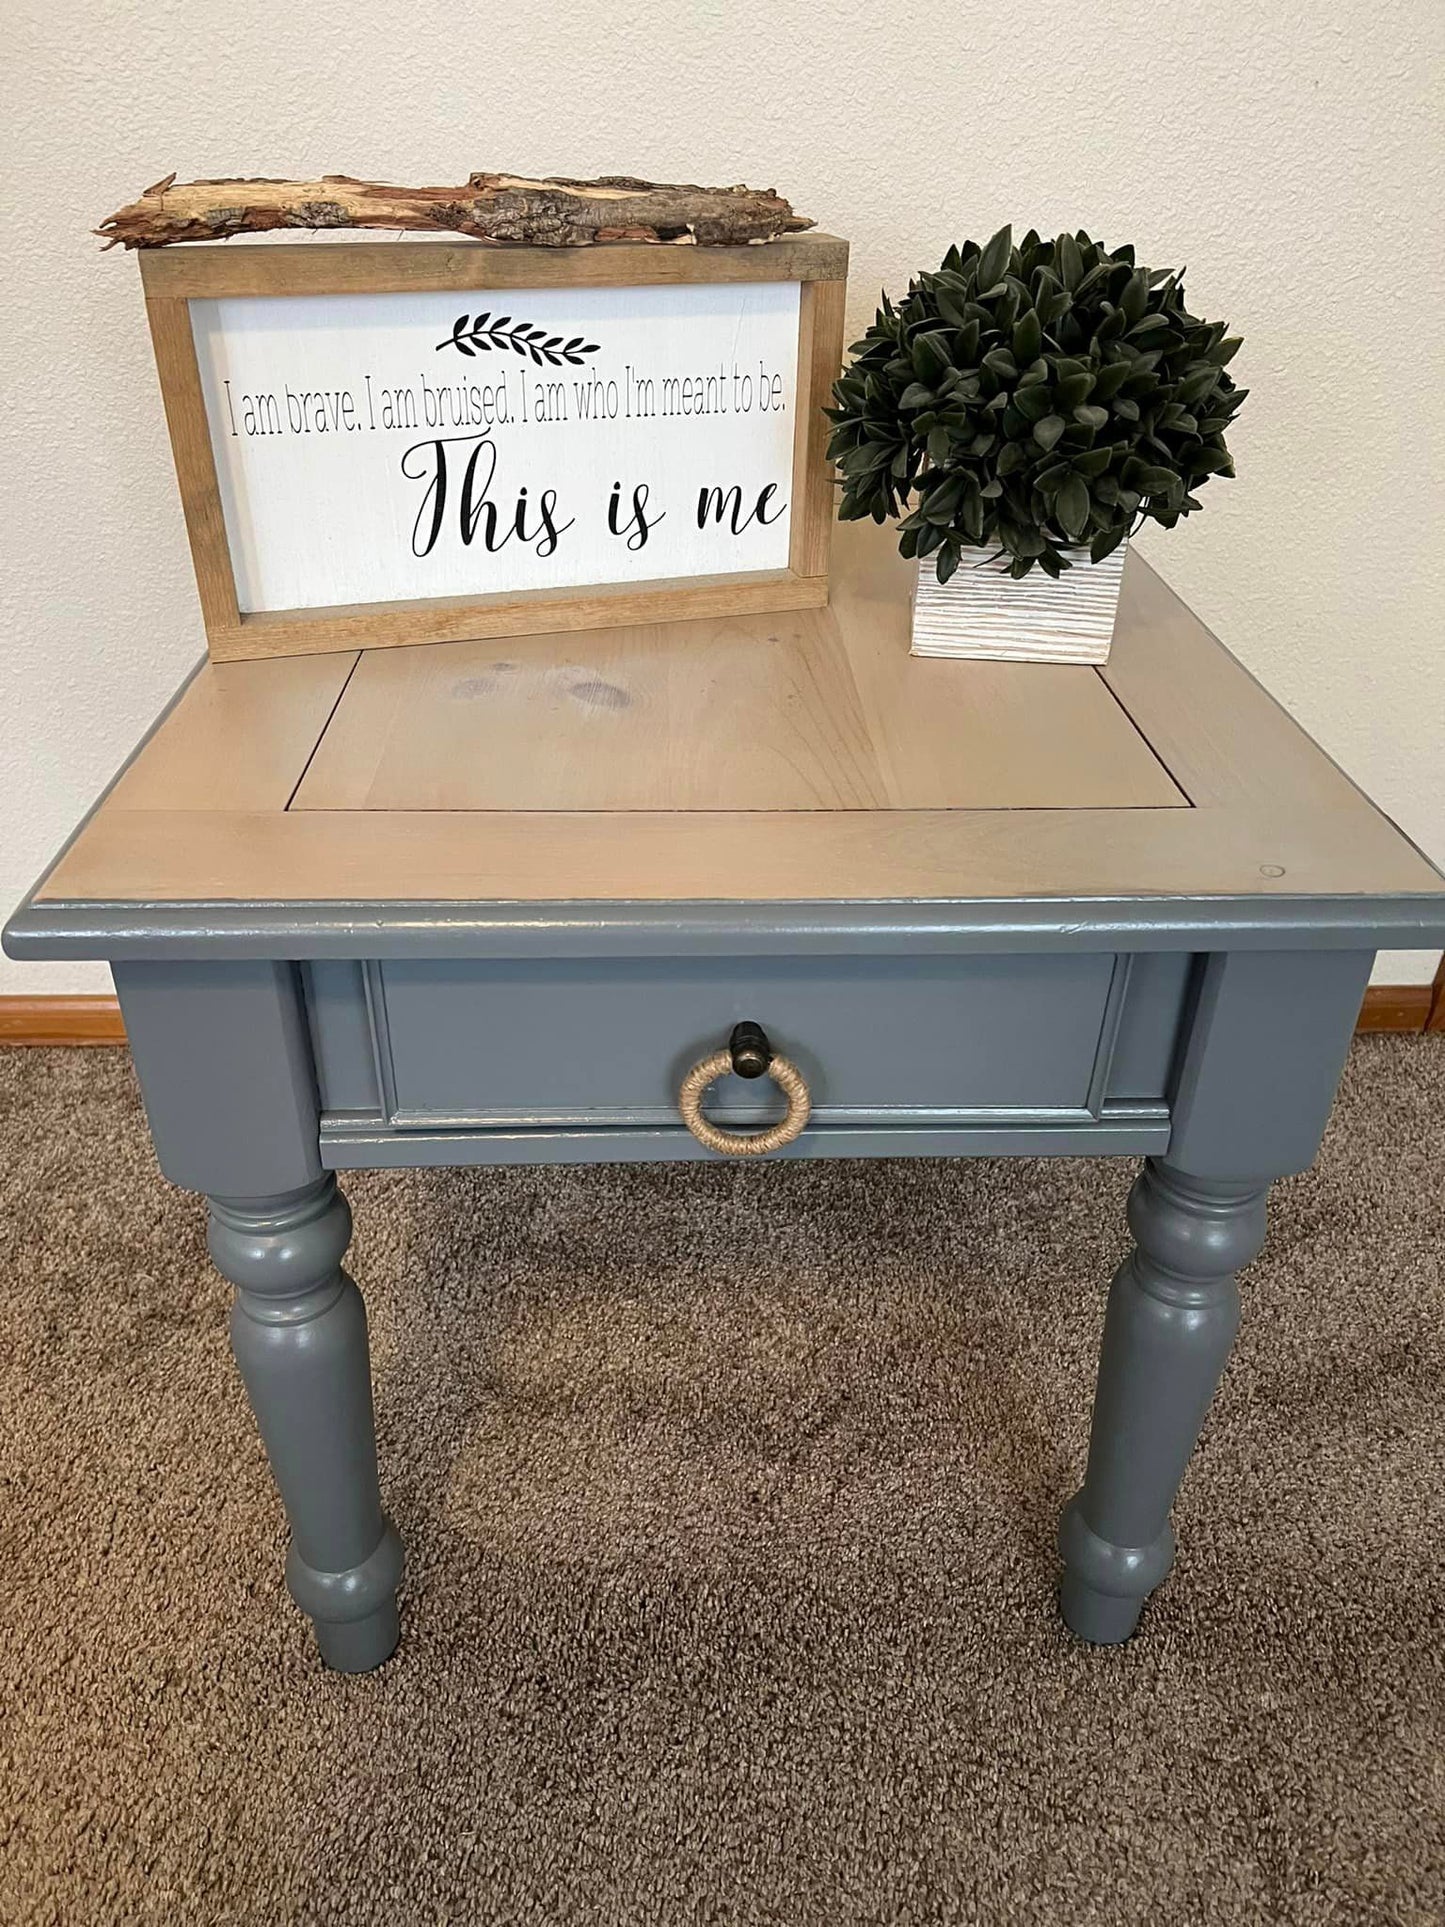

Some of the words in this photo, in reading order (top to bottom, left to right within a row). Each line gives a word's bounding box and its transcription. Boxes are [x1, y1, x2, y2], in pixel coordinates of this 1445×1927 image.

[224, 380, 238, 436] I
[242, 394, 283, 435] am
[285, 384, 362, 433] brave.
[365, 376, 379, 429] I
[382, 389, 418, 429] am
[421, 371, 515, 426] bruised.
[520, 370, 530, 422] I
[534, 382, 569, 421] am
[573, 367, 618, 420] who
[625, 365, 656, 417] I'm
[661, 362, 729, 415] meant
[733, 362, 753, 412] to
[758, 361, 787, 412] be.
[400, 428, 576, 558] This
[607, 481, 666, 551] is
[697, 482, 787, 535] me
